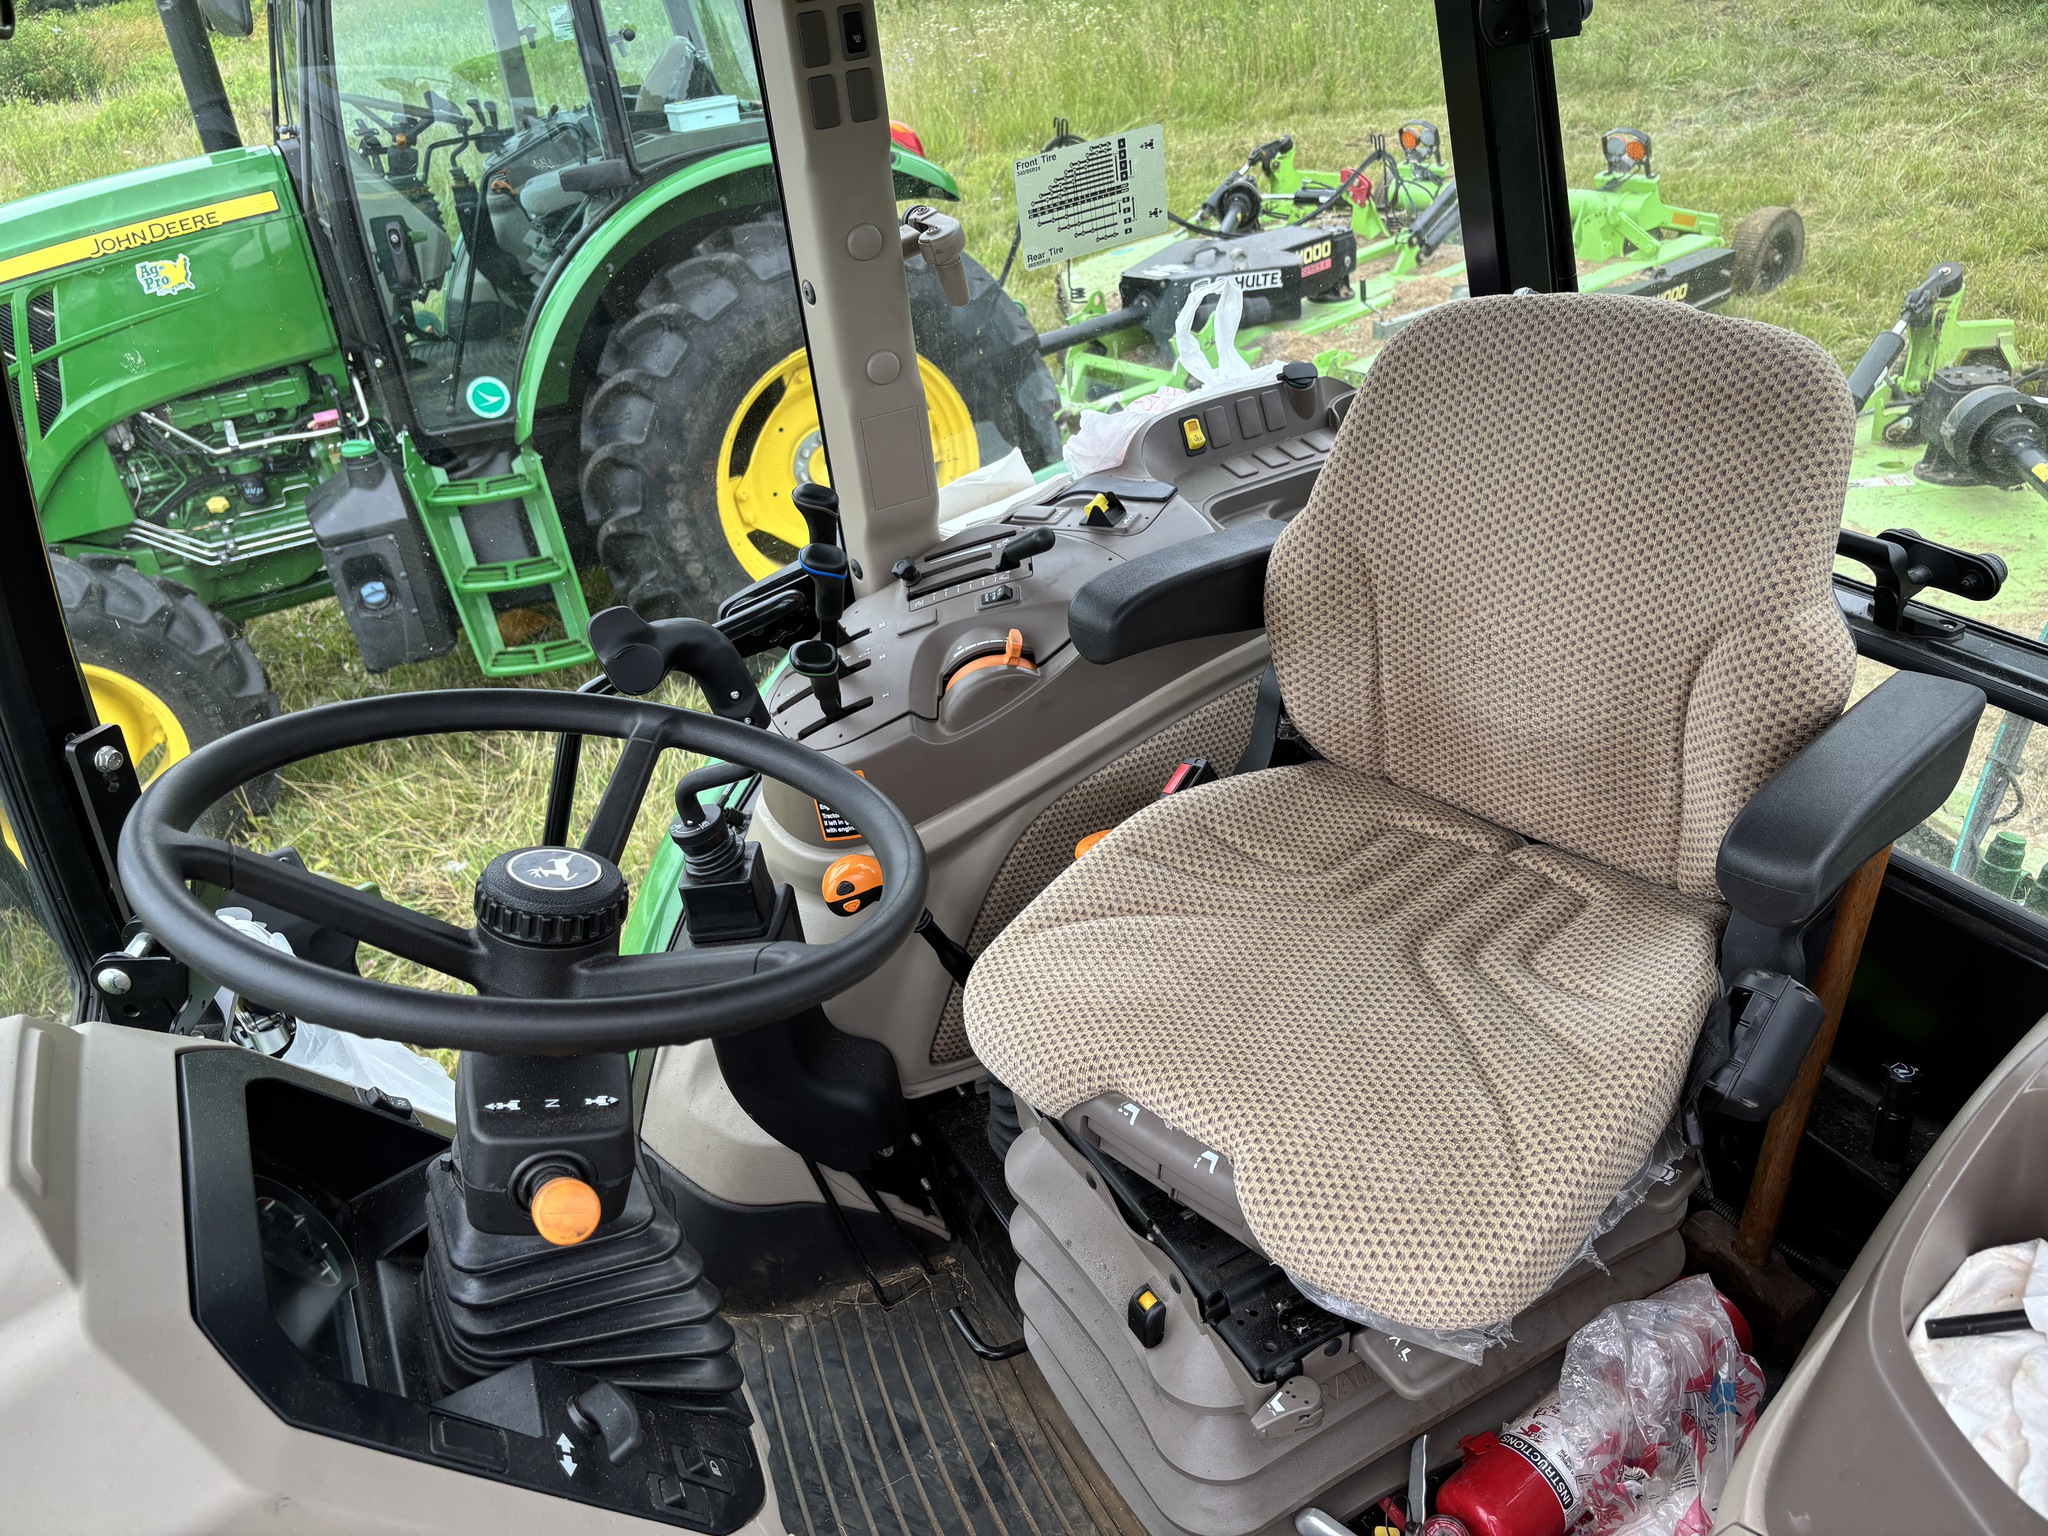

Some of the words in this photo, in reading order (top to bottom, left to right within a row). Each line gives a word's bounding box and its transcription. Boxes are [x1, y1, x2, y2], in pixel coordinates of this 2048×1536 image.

[1015, 157, 1038, 171] Front
[1040, 153, 1057, 164] Tire
[91, 229, 147, 255] JOHN
[148, 211, 219, 238] DEERE
[1027, 251, 1046, 263] Rear
[1048, 246, 1064, 256] Tire
[143, 275, 170, 290] Pro
[1235, 273, 1279, 289] HULTE
[1500, 1434, 1571, 1507] INSTRUCTIONS
